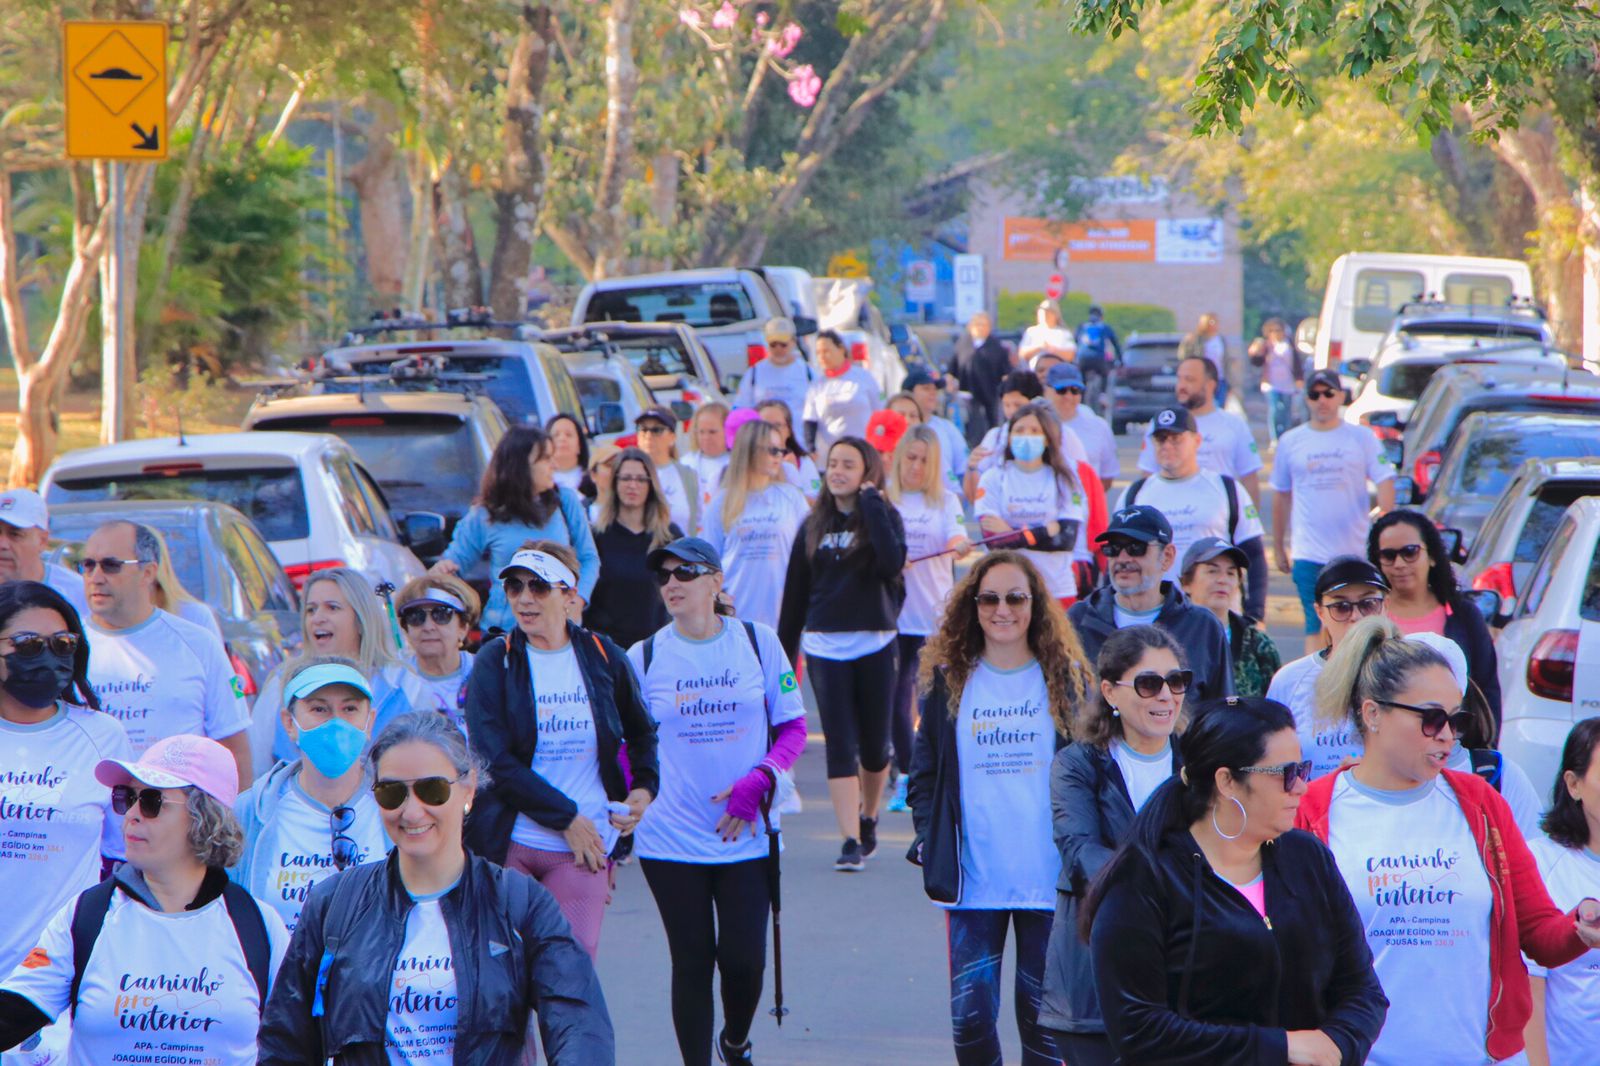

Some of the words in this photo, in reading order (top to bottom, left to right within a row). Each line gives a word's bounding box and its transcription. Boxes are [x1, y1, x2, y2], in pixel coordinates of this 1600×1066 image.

[676, 668, 740, 691] caminho
[680, 698, 743, 716] interior
[972, 700, 1042, 720] caminho
[977, 727, 1041, 746] interior
[0, 766, 67, 788] minho
[0, 796, 63, 821] terior
[8, 830, 47, 839] Campinas
[1366, 847, 1461, 873] caminho
[1368, 872, 1402, 897] pro
[1376, 880, 1463, 907] interior
[1411, 916, 1450, 925] Campinas
[1368, 928, 1405, 937] JOAQUIM
[1438, 929, 1449, 937] km
[1420, 938, 1433, 946] km
[120, 966, 224, 996] caminho
[114, 994, 154, 1017] pro
[389, 985, 459, 1015] nterio
[120, 1004, 222, 1032] interior
[134, 1042, 153, 1050] APA
[160, 1042, 204, 1053] Campinas
[112, 1054, 152, 1064] JOAQUIM
[154, 1053, 187, 1065] EGÍDIO
[188, 1057, 202, 1065] km
